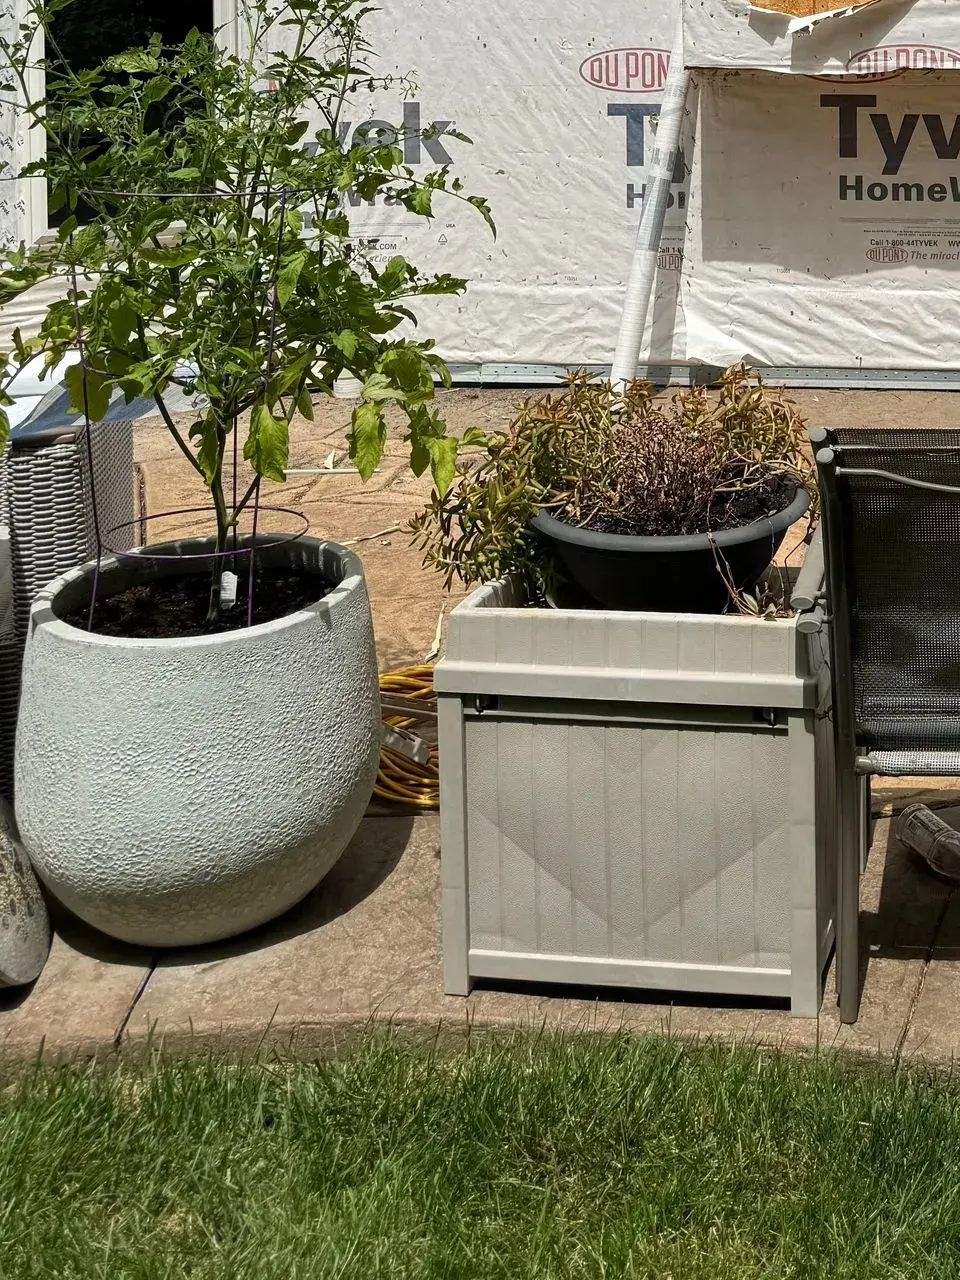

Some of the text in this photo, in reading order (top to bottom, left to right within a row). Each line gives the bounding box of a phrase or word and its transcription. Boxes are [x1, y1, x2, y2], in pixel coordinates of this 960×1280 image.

[870, 239, 884, 247] Call
[885, 239, 938, 248] 1-800-44TYVEK
[910, 250, 927, 260] The
